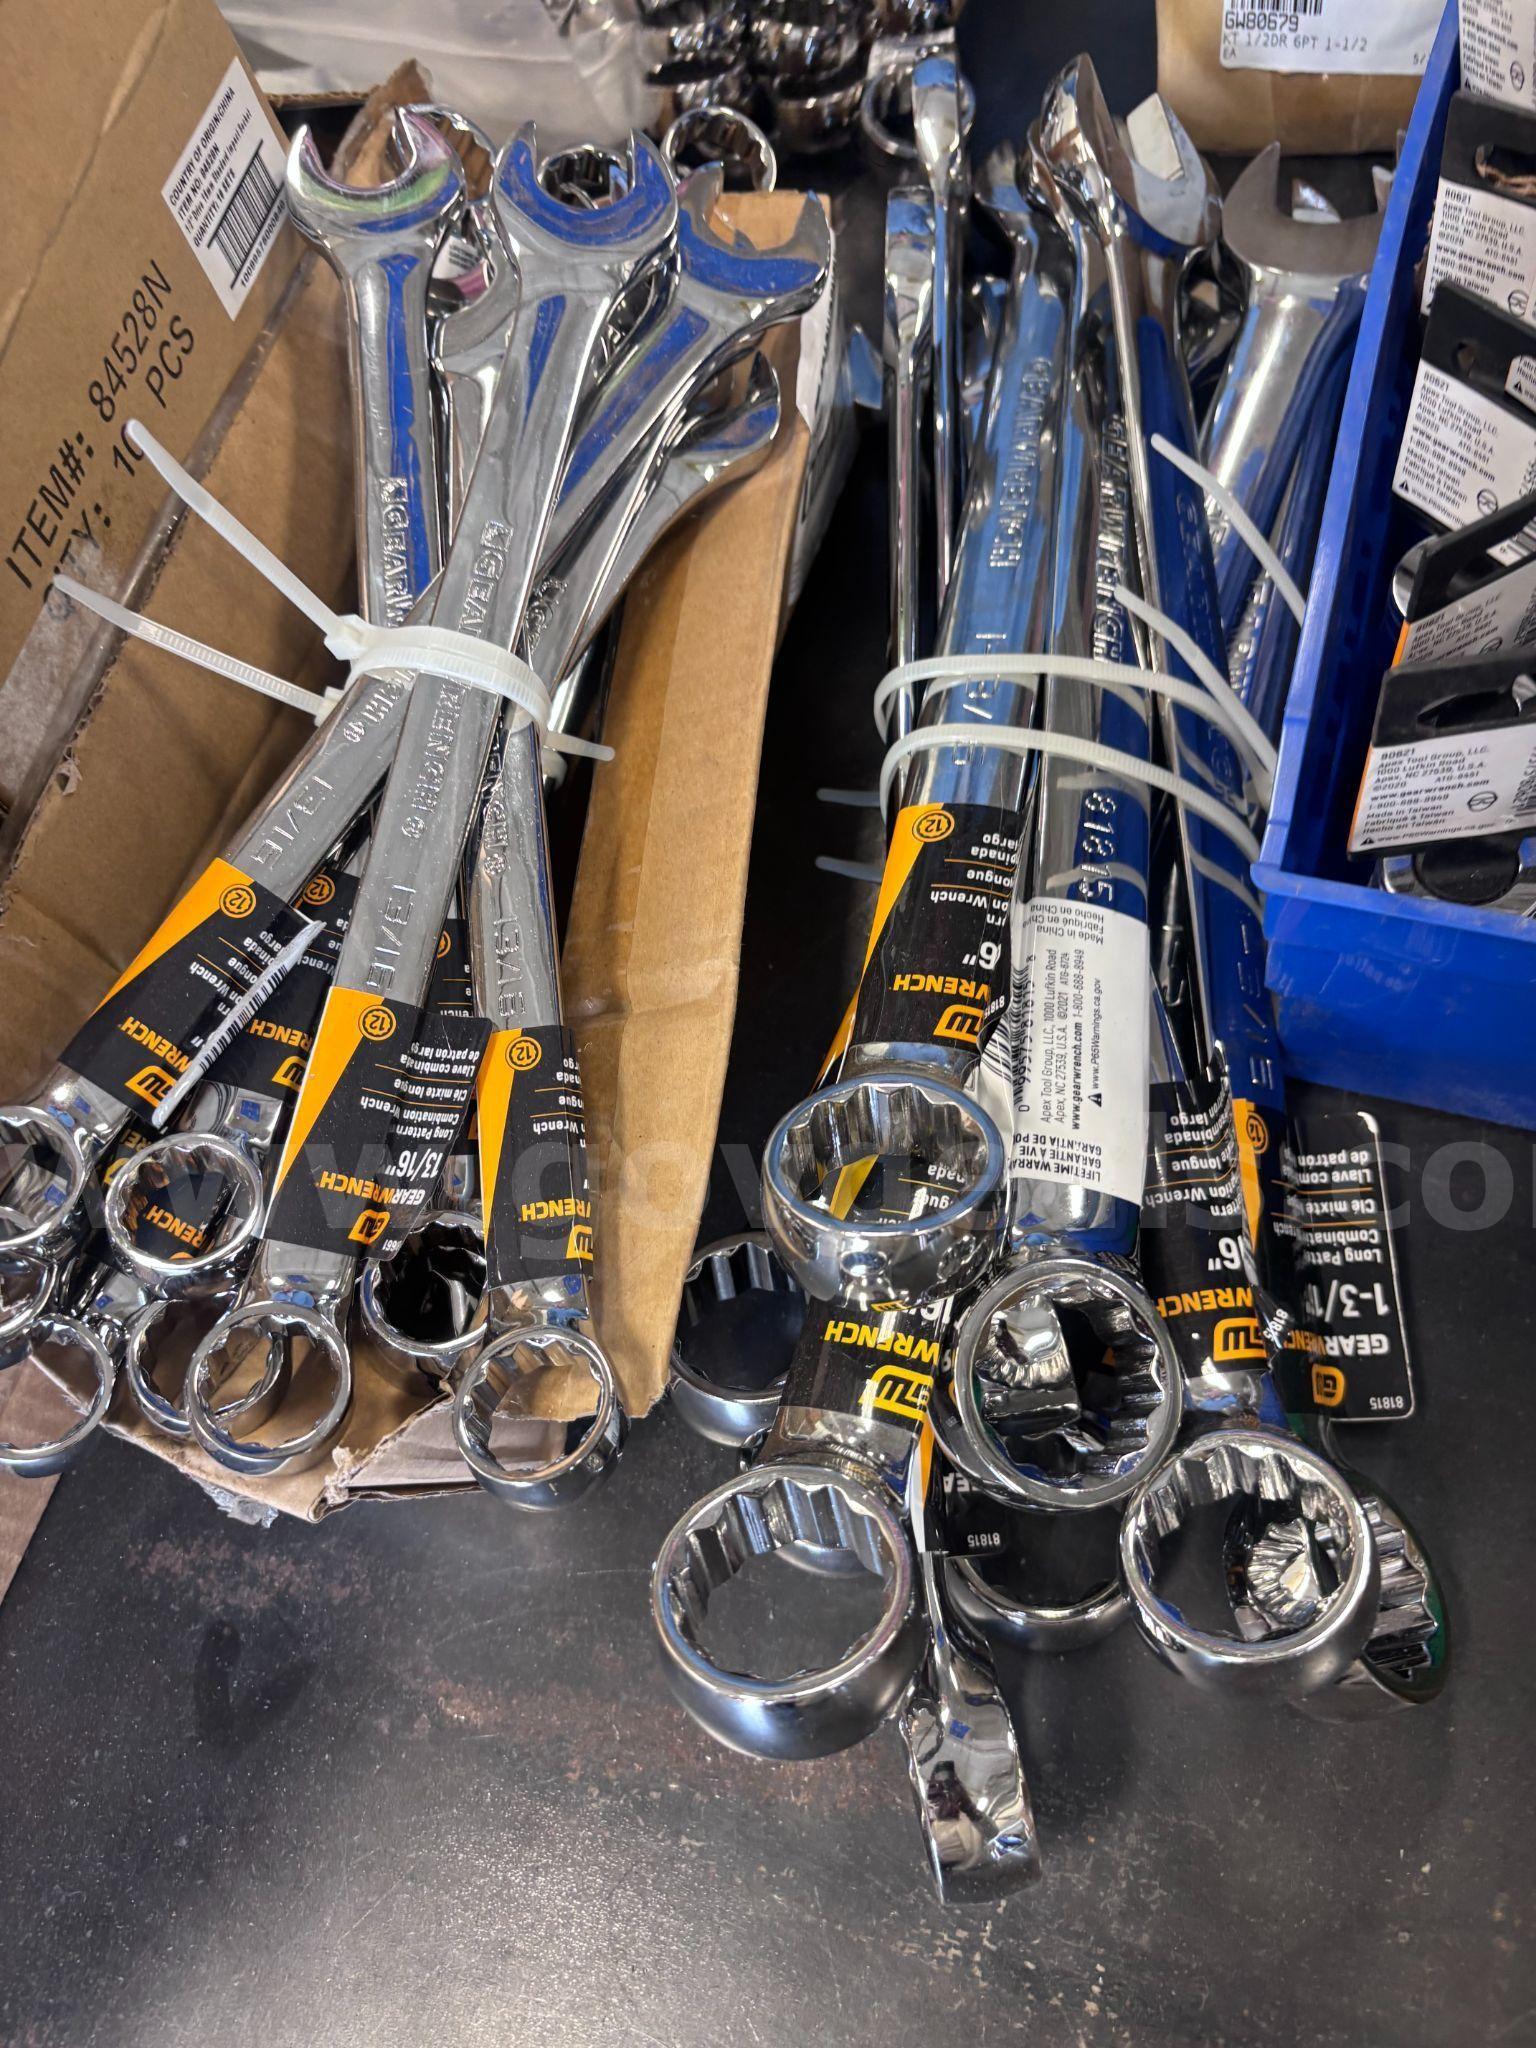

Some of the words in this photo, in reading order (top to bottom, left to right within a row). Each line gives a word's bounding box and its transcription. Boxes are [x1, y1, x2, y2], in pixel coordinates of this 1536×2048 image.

[1225, 13, 1299, 31] GW80679
[1245, 33, 1287, 47] 1/2DR
[1294, 35, 1318, 48] 6PT
[1325, 36, 1368, 51] 1-1/2
[169, 162, 195, 207] COUNTRY
[193, 146, 203, 167] OF
[177, 193, 192, 221] ITEM
[145, 314, 195, 409] PCS
[5, 430, 95, 591] ITEM#:
[88, 258, 173, 424] 84528N
[1381, 748, 1415, 760] 80621
[1370, 779, 1490, 801] www.gearwrench.com
[1366, 809, 1394, 819] Made
[925, 819, 943, 834] 12
[1362, 825, 1394, 834] Hecho
[1084, 792, 1116, 901] 81815
[228, 891, 249, 912] 12
[930, 890, 989, 910] Wrench
[1031, 904, 1058, 915] China
[1075, 908, 1104, 924] Hecho
[1036, 925, 1065, 938] China
[1067, 929, 1076, 939] in
[1078, 930, 1104, 946] Made
[1062, 917, 1104, 935] Fabriqué
[1045, 948, 1057, 971] Road
[188, 961, 229, 1001] Wrench
[1045, 972, 1057, 1001] Lufkin
[1072, 949, 1085, 1018] 1-800-688-8949
[1044, 1002, 1056, 1023] 1000
[1057, 991, 1069, 1020] ©2021
[370, 1014, 387, 1031] 12
[1090, 978, 1103, 1090] www.P65Warnings.ca.gov
[468, 1050, 480, 1062] de
[515, 1045, 532, 1060] 12
[1042, 1047, 1055, 1077] Group,
[452, 1062, 476, 1078] Llave
[1055, 1051, 1068, 1081] 27539,
[1070, 1022, 1083, 1130] www.gearwrench.com
[426, 1086, 453, 1099] mixte
[453, 1088, 468, 1102] Clé
[1041, 1078, 1052, 1098] Tool
[1055, 1081, 1066, 1096] NC
[359, 1096, 401, 1119] Wrench
[402, 1108, 460, 1125] Combination
[1040, 1098, 1052, 1123] Apex
[1054, 1096, 1066, 1123] Apex,
[396, 1124, 433, 1141] Pattern
[434, 1126, 454, 1142] Long
[532, 1119, 579, 1135] Wrench
[1032, 1133, 1047, 1145] DE
[384, 1147, 443, 1182] 13/16"
[1019, 1146, 1037, 1157] VIE
[1049, 1149, 1101, 1169] GARANTIE
[1171, 1155, 1222, 1173] longue
[1349, 1149, 1369, 1165] de
[1009, 1158, 1051, 1172] WARRA
[1054, 1162, 1101, 1182] LIFETIME
[1331, 1169, 1372, 1185] Llave
[317, 1170, 426, 1206] GEARWRENCH
[1144, 1185, 1204, 1207] Wrench
[1305, 1201, 1348, 1216] mixte
[1351, 1198, 1377, 1213] Clé
[1344, 1247, 1382, 1265] Long
[1369, 1395, 1405, 1410] 81815
[967, 1532, 1001, 1549] 81815
